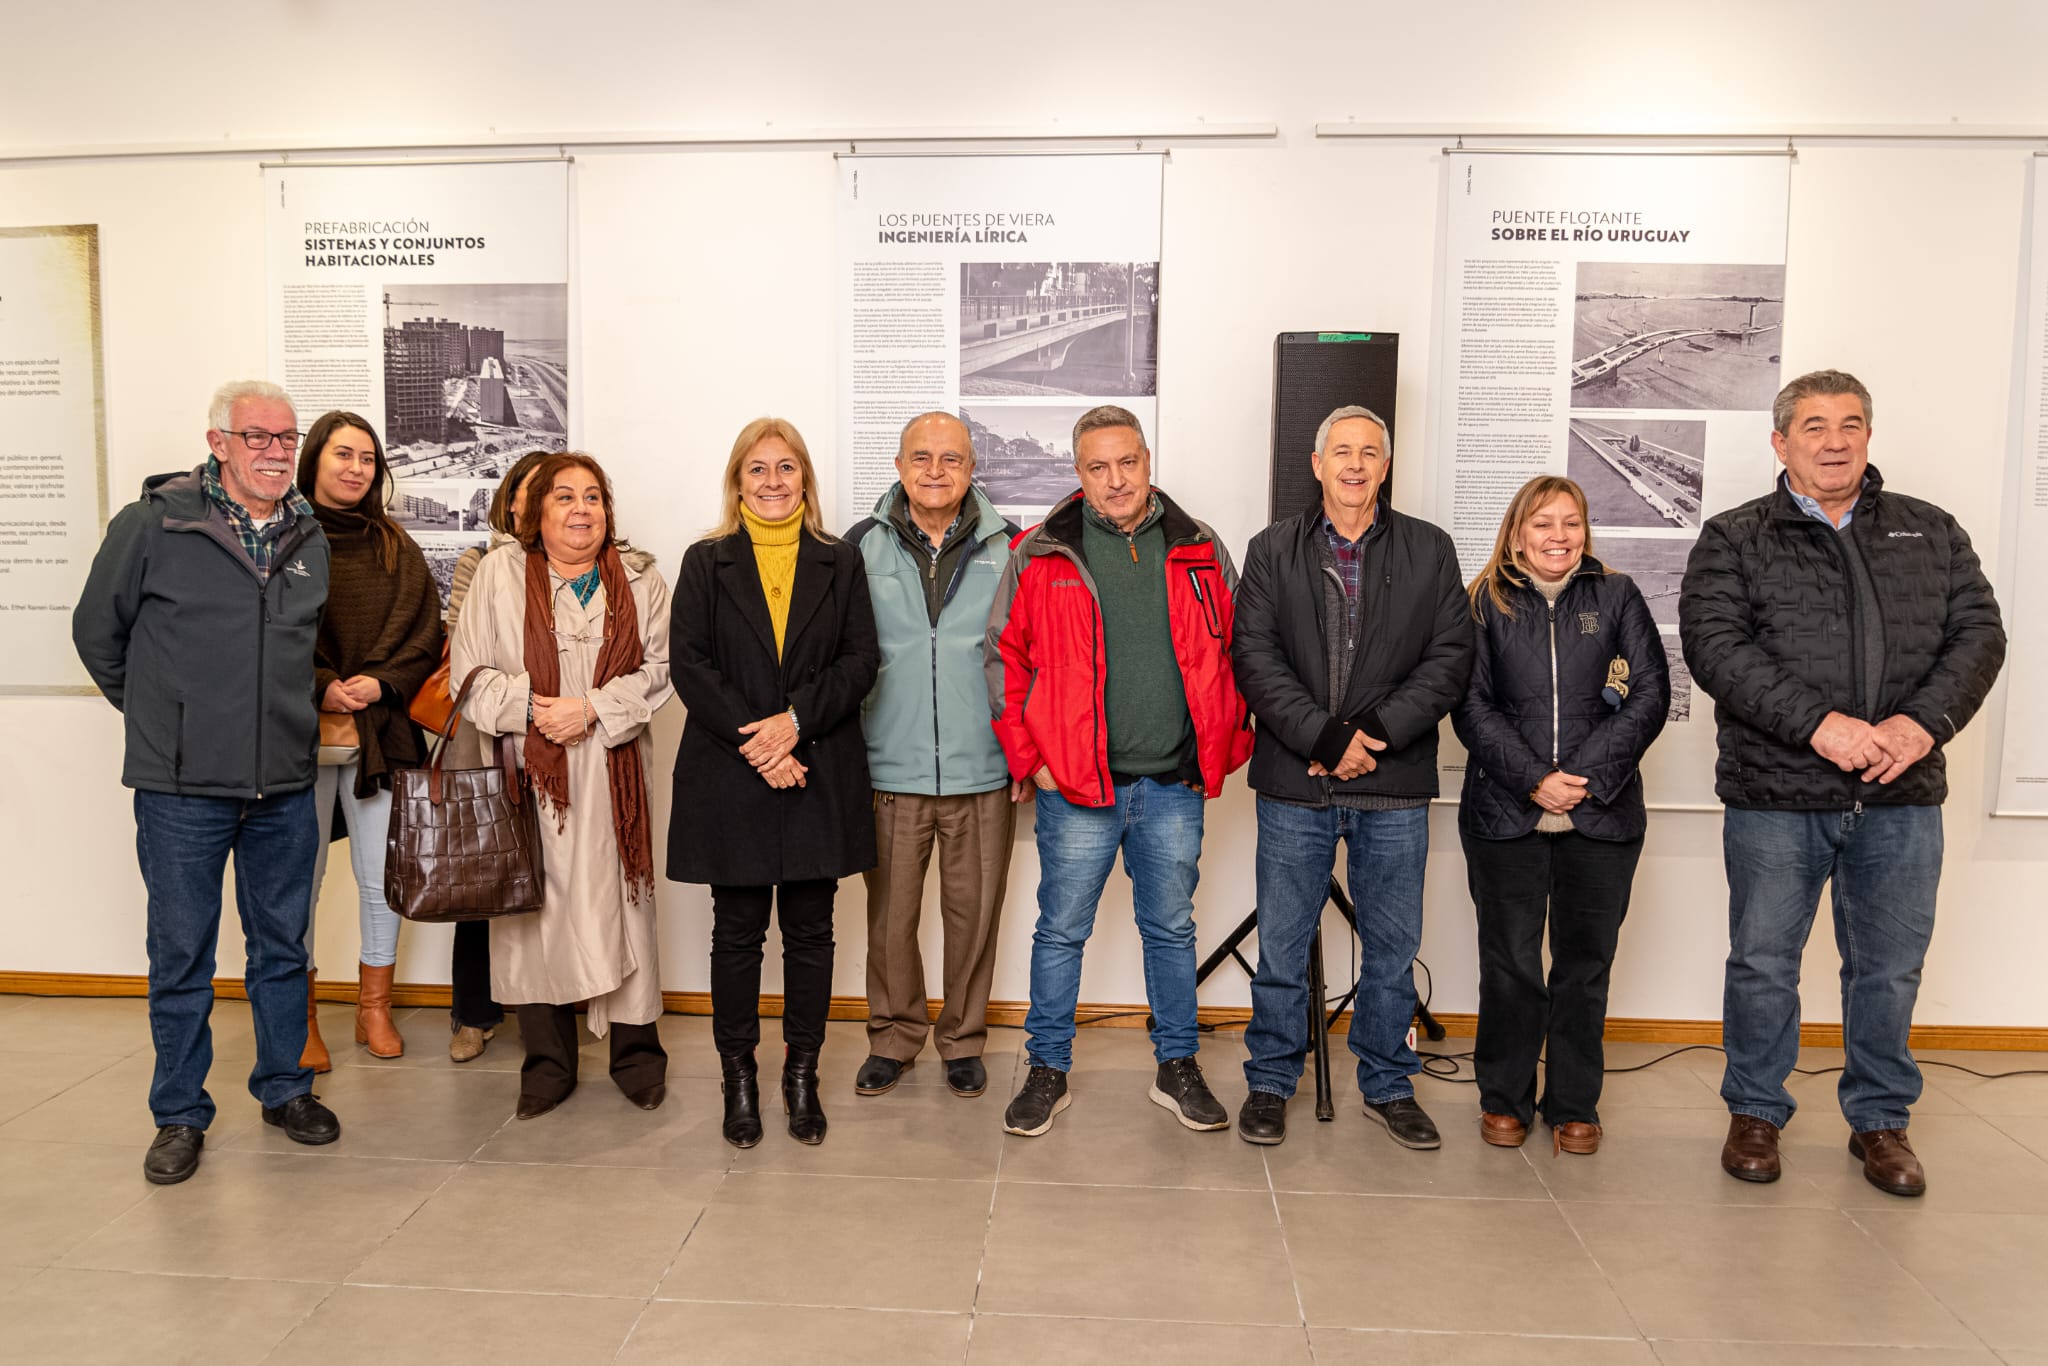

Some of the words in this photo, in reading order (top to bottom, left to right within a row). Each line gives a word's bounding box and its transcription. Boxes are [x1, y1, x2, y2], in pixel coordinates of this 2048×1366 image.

[879, 213, 908, 227] LOS
[912, 213, 981, 227] PUENTES
[985, 213, 1005, 226] DE
[1009, 213, 1056, 226] VIERA
[1492, 210, 1555, 224] PUENTE
[1560, 211, 1642, 225] FLOTANTE
[305, 217, 429, 234] PREFABRICACIÓN
[879, 227, 971, 243] INGENIERÍA
[975, 227, 1028, 243] LÍRICA
[1491, 228, 1547, 241] SOBRE
[1551, 228, 1569, 241] EL
[1573, 225, 1603, 242] RÍO
[1607, 229, 1690, 243] URUGUAY
[305, 238, 376, 250] SISTEMAS
[380, 238, 390, 250] Y
[393, 237, 485, 250] CONJUNTOS
[305, 254, 435, 267] HABITACIONALES
[38, 357, 60, 365] cultural
